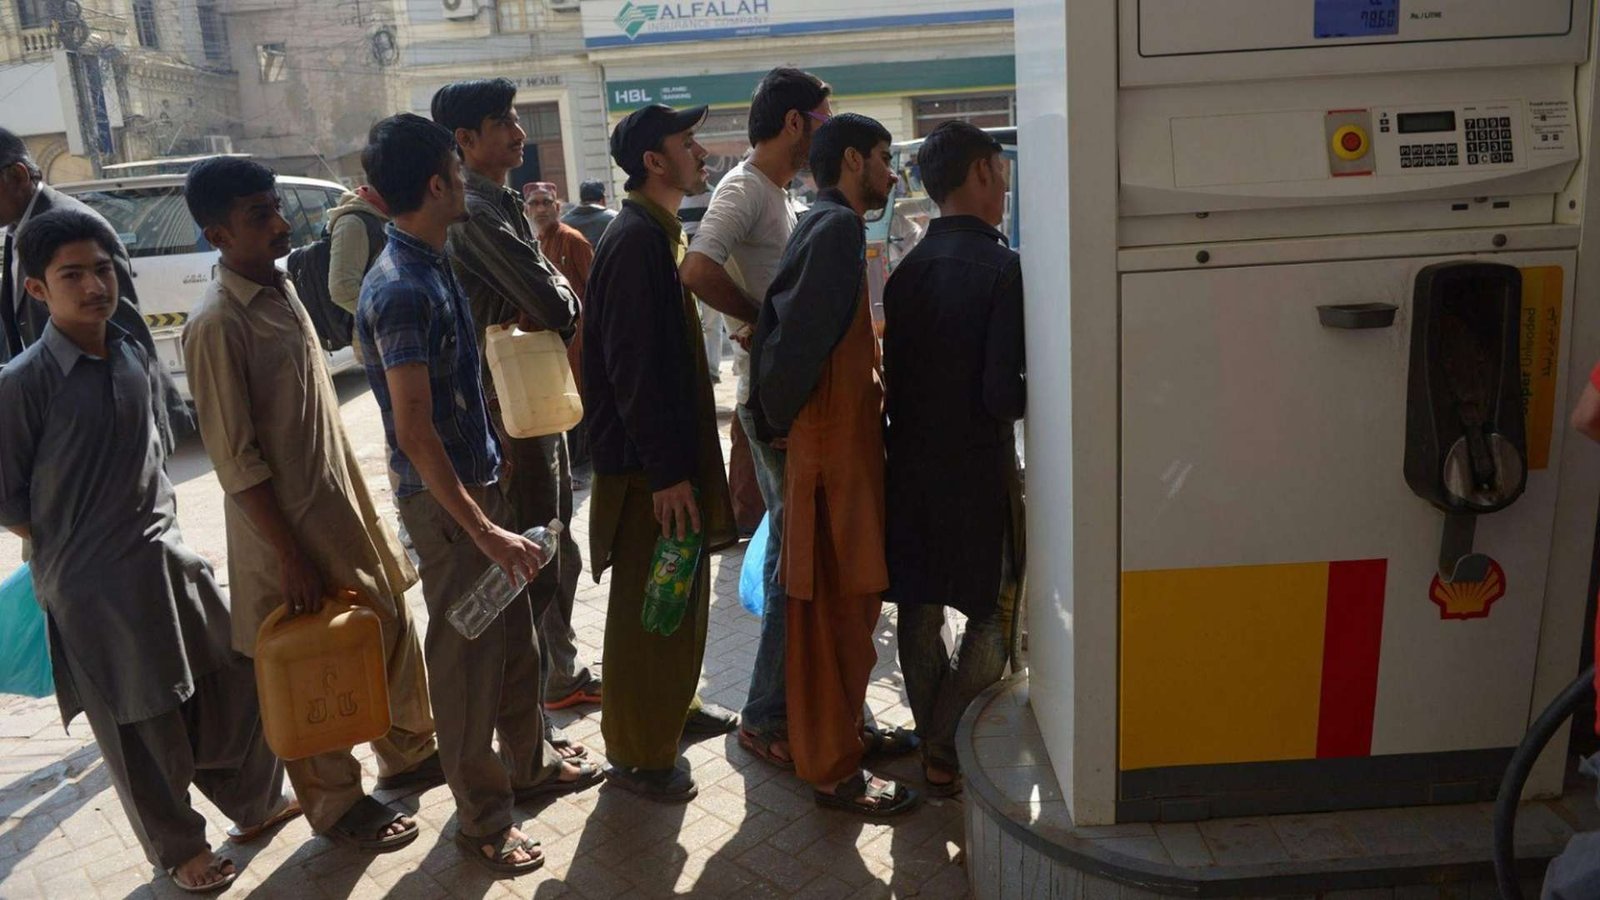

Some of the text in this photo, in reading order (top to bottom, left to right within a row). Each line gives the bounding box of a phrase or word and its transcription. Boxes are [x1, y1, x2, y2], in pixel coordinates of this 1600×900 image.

[660, 0, 769, 19] ALFALAH
[647, 16, 769, 32] INSURANCE COMPANY
[615, 89, 652, 103] HBL
